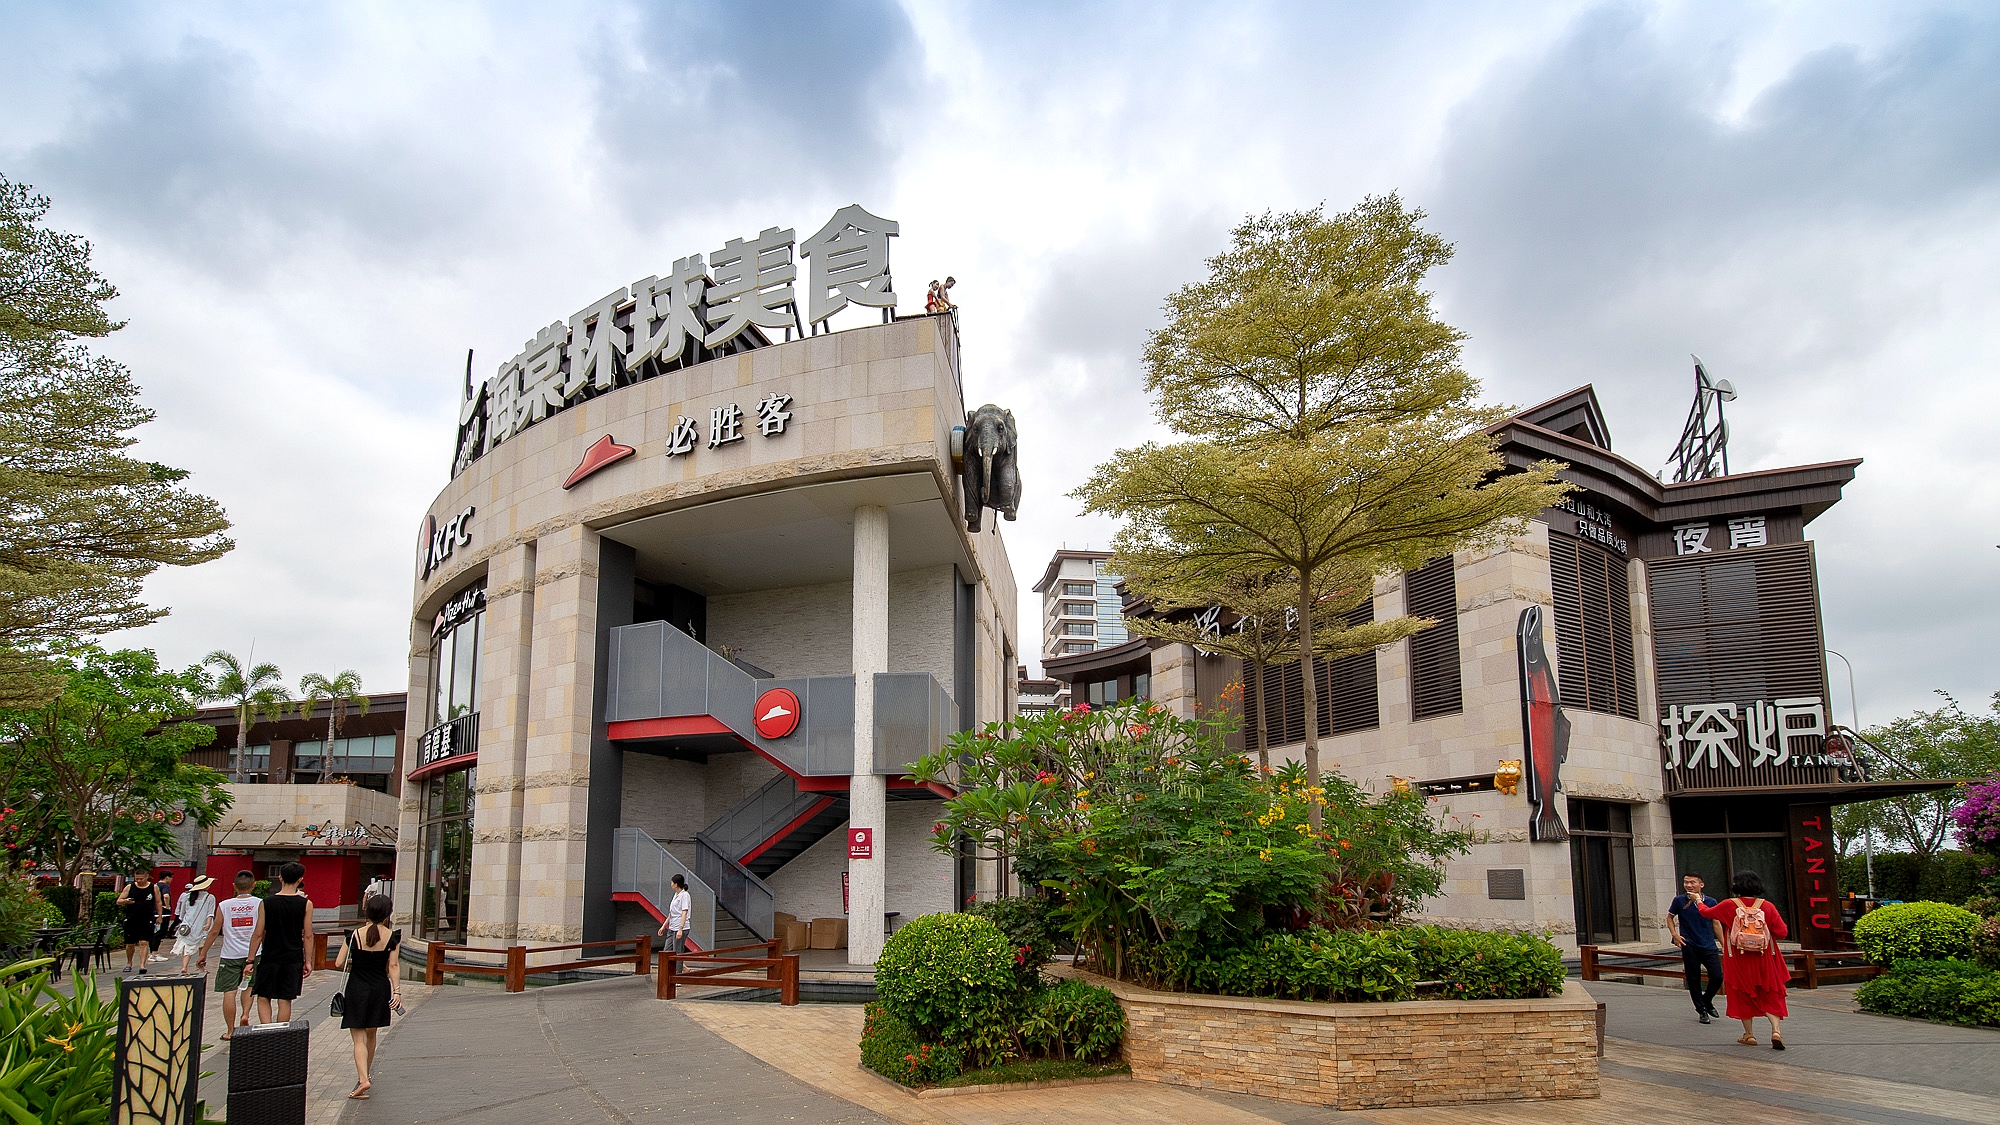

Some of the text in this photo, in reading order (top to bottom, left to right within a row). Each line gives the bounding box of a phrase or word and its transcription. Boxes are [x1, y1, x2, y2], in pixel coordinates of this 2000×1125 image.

[665, 392, 793, 458] 必胜客
[430, 506, 476, 570] KFC
[1672, 515, 1768, 556] 夜宵
[442, 588, 480, 628] Pizza Hut
[423, 723, 452, 765] 肯德基
[1660, 696, 1826, 770] 探炉
[1802, 815, 1831, 929] TAN-LU
